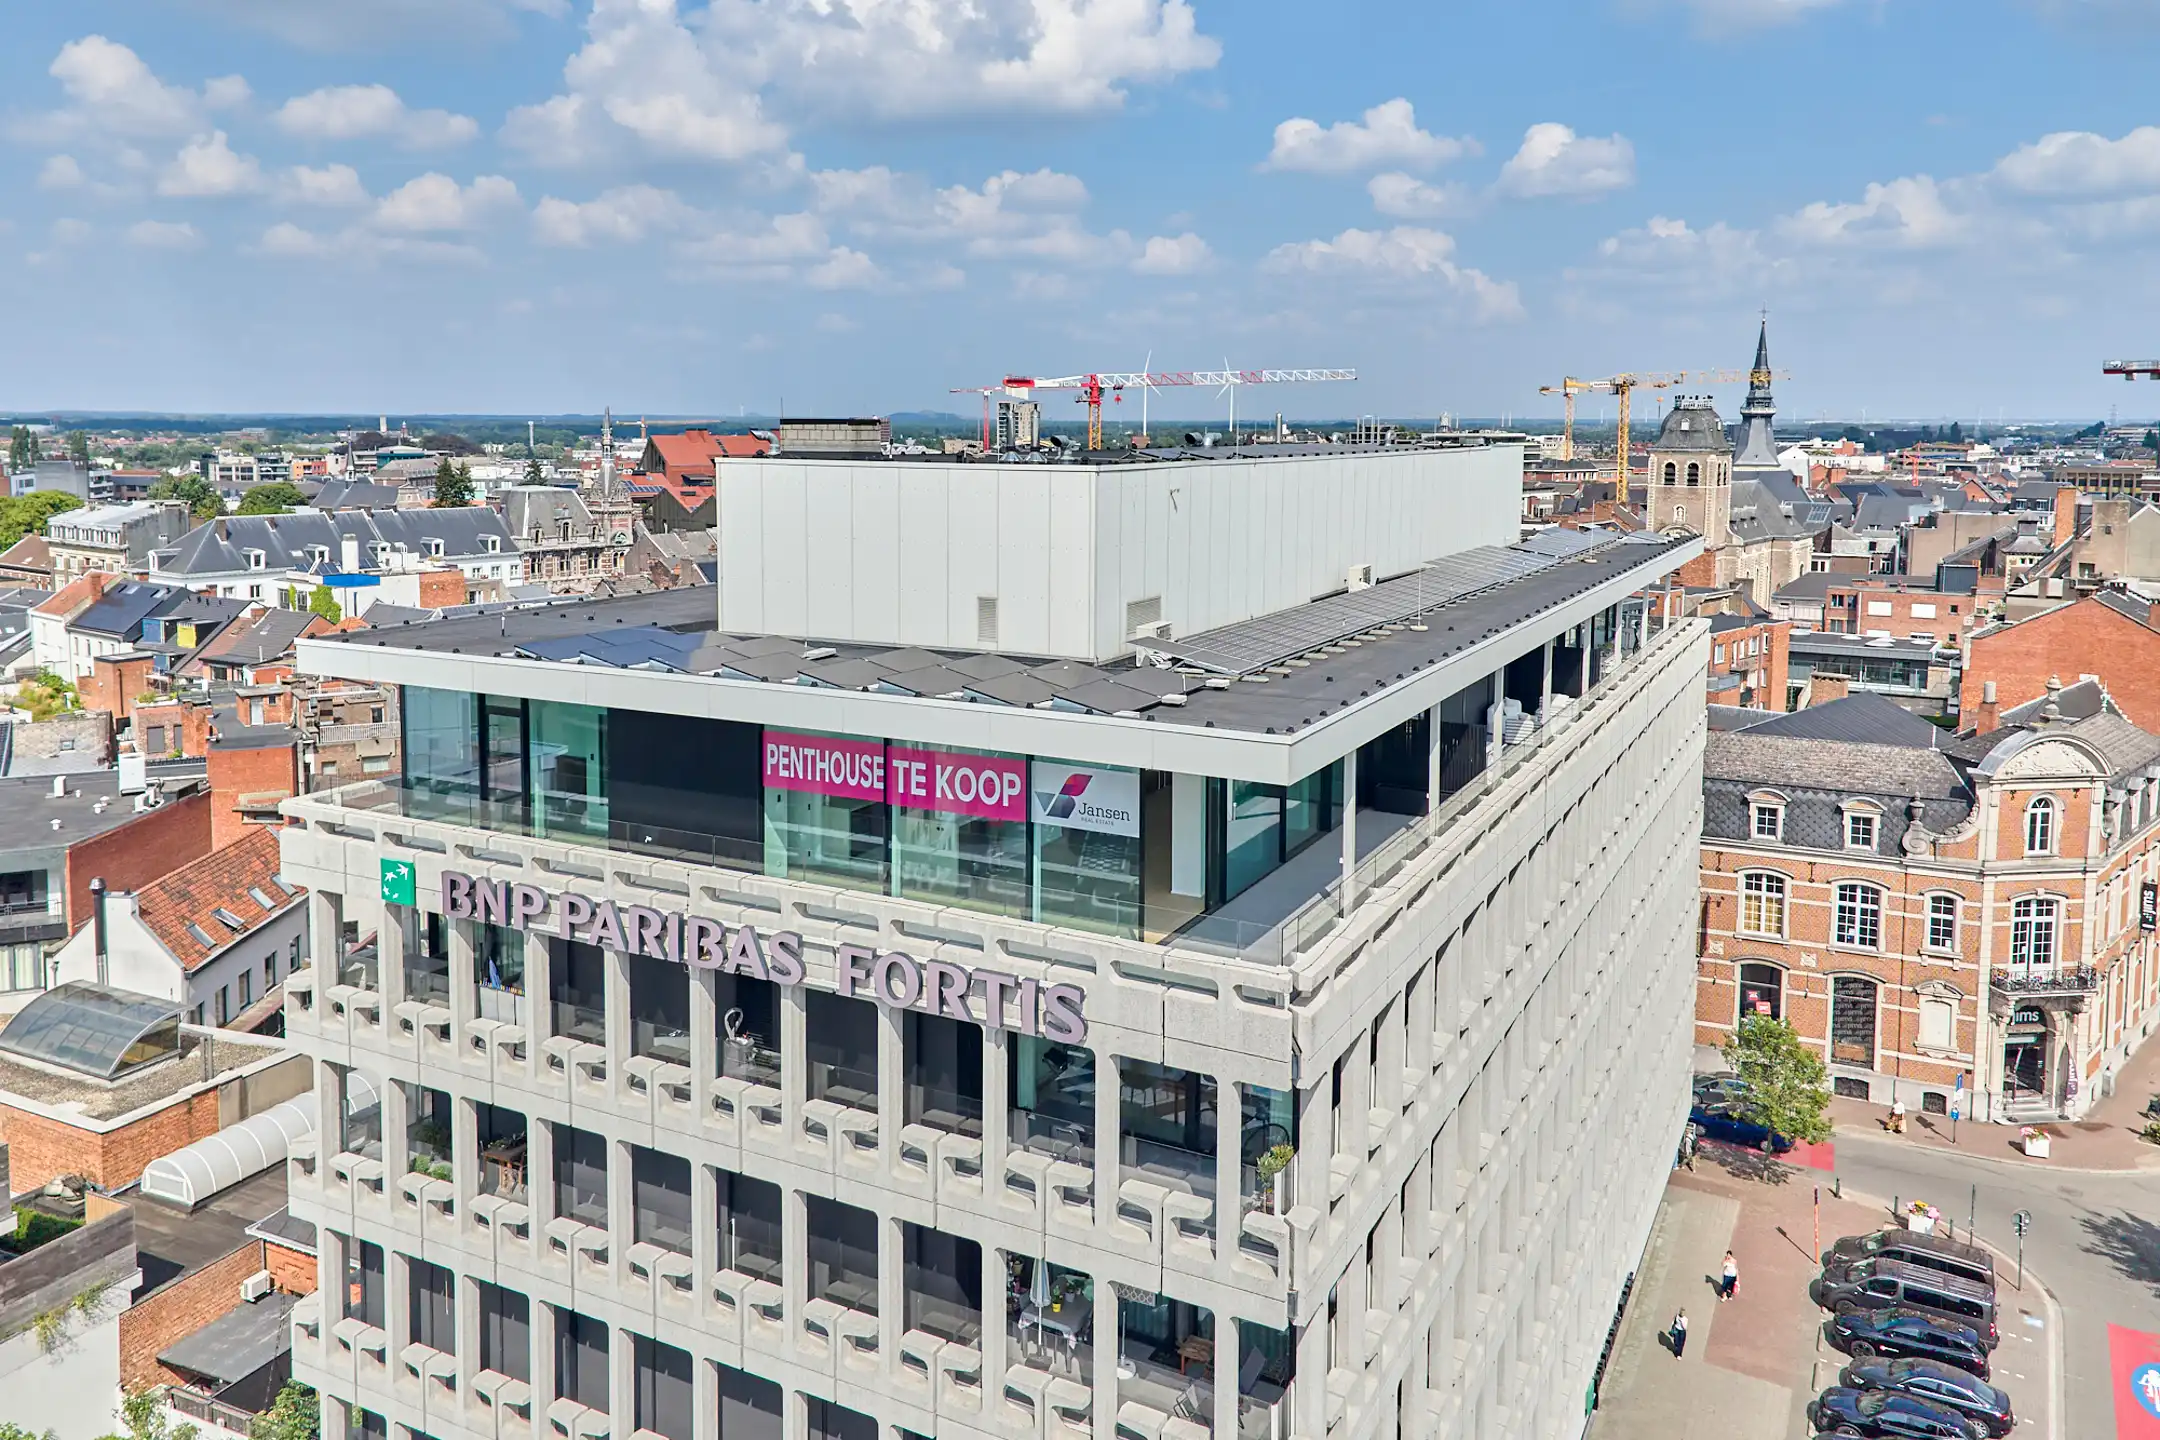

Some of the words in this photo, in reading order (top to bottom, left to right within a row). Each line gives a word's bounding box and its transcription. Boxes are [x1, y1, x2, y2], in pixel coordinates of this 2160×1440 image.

[767, 743, 884, 790] PENTHOUSE
[893, 759, 926, 796] TE
[935, 764, 1021, 807] KOOP
[1079, 803, 1131, 821] Jansen
[1095, 818, 1114, 826] ESTATE
[2143, 890, 2156, 915] jims
[441, 870, 549, 931] BNP
[558, 891, 807, 986] PARIBAS
[837, 942, 1088, 1045] FORTIS
[2010, 1010, 2040, 1026] jims
